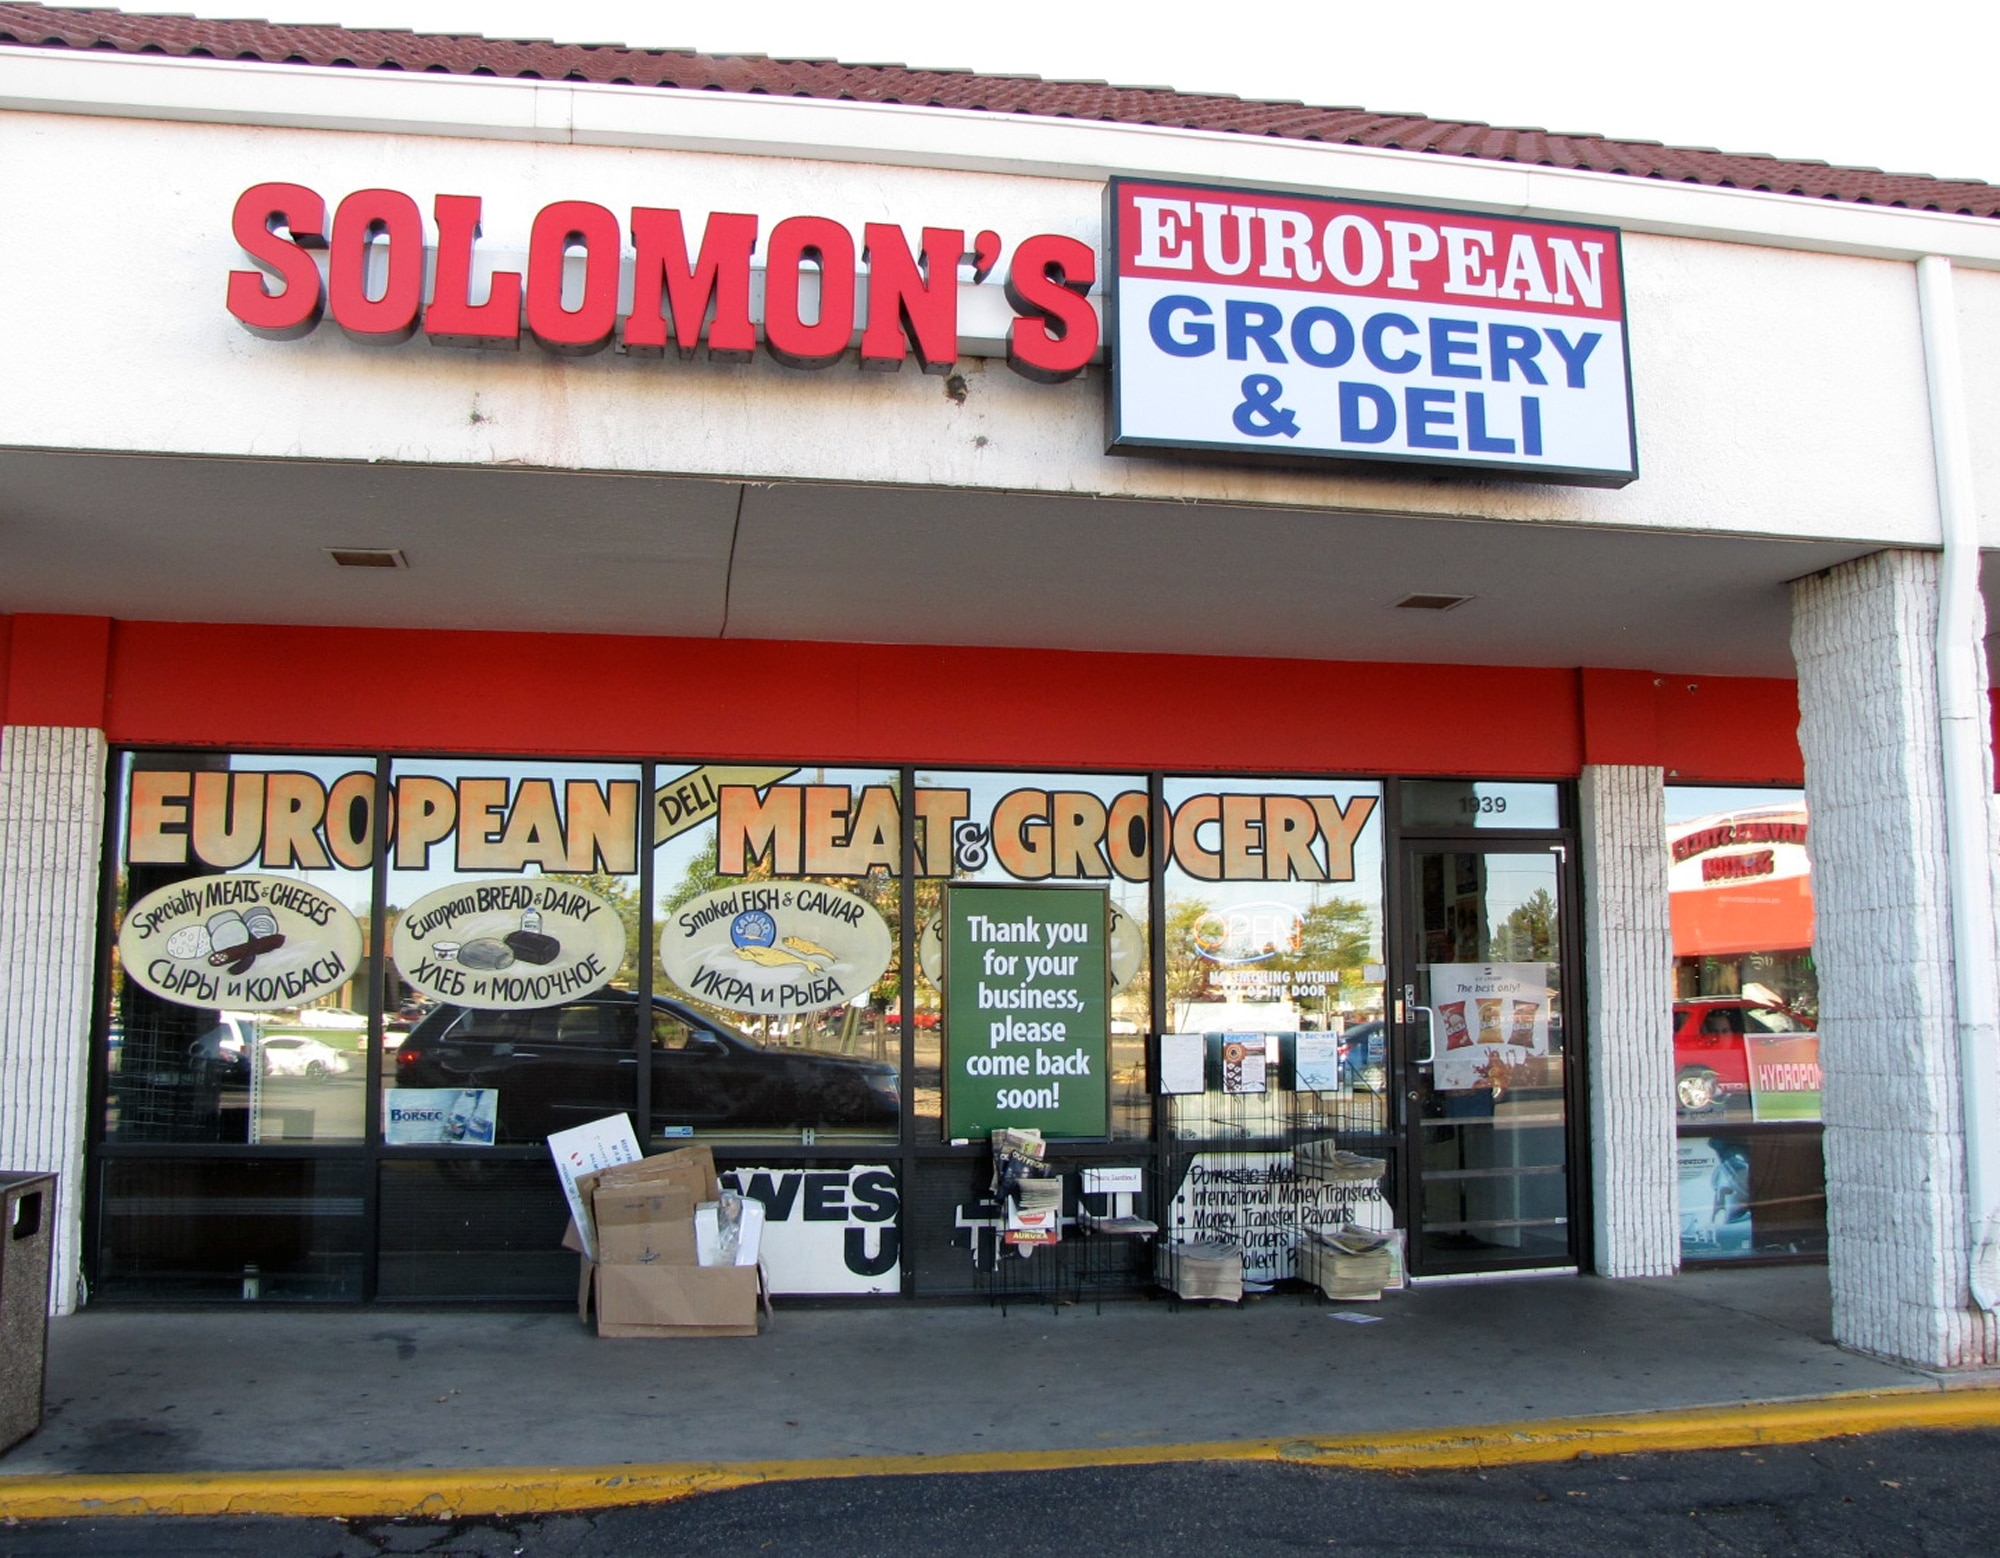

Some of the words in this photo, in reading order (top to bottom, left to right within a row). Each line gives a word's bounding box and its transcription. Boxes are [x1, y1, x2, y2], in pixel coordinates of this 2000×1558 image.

[1132, 196, 1604, 308] EUROPEAN
[226, 181, 1100, 376] SOLOMON'S
[1147, 294, 1602, 390] GROCERY
[1231, 373, 1300, 440] &
[1338, 380, 1543, 457] DELI
[658, 774, 718, 827] DELI
[1460, 796, 1507, 815] 1939
[125, 769, 641, 875] EUROPEAN
[716, 784, 971, 879] MEAT
[955, 822, 990, 871] &
[989, 786, 1380, 884] GROCERY
[132, 885, 203, 940] Specialty
[200, 879, 261, 904] MEATS
[269, 882, 337, 927] CHEESES
[405, 892, 477, 940] European
[476, 886, 533, 914] BREAD
[542, 890, 601, 924] DAIRY
[678, 890, 740, 939] Smoked
[741, 888, 780, 913] FISH
[797, 888, 867, 929] CAVIAR
[967, 915, 1041, 943] Thank
[1045, 921, 1089, 950] you
[1193, 911, 1304, 951] OPEN
[148, 957, 221, 1002] СЫРЫ
[246, 951, 346, 1003] КОЛБАСЫ
[410, 955, 466, 997] ХЛЕБ
[491, 952, 607, 1003] МОЛОЧНОЕ
[983, 947, 1019, 976] for
[1025, 955, 1079, 983] your
[1234, 970, 1292, 984] SMOKING
[1294, 970, 1340, 984] WITHIN
[690, 963, 755, 1008] ИКРА
[779, 974, 845, 1009] РЫБА
[978, 981, 1085, 1014] business,
[1266, 984, 1289, 998] THE
[1291, 984, 1327, 997] DOOR
[1456, 983, 1473, 993] The
[1474, 983, 1495, 993] best
[1497, 982, 1521, 993] only!
[990, 1014, 1067, 1050] please
[966, 1054, 1030, 1076] come
[1035, 1048, 1090, 1076] back
[996, 1081, 1061, 1110] soon!
[391, 1109, 444, 1121] BORSEC
[1192, 1186, 1273, 1206] International
[1278, 1183, 1320, 1205] Money
[1323, 1183, 1382, 1203] Transfers
[1193, 1208, 1236, 1229] Money
[1242, 1207, 1296, 1227] Transfer
[1301, 1206, 1354, 1225] Payouts
[844, 1226, 899, 1277] U
[1243, 1229, 1289, 1248] Orders
